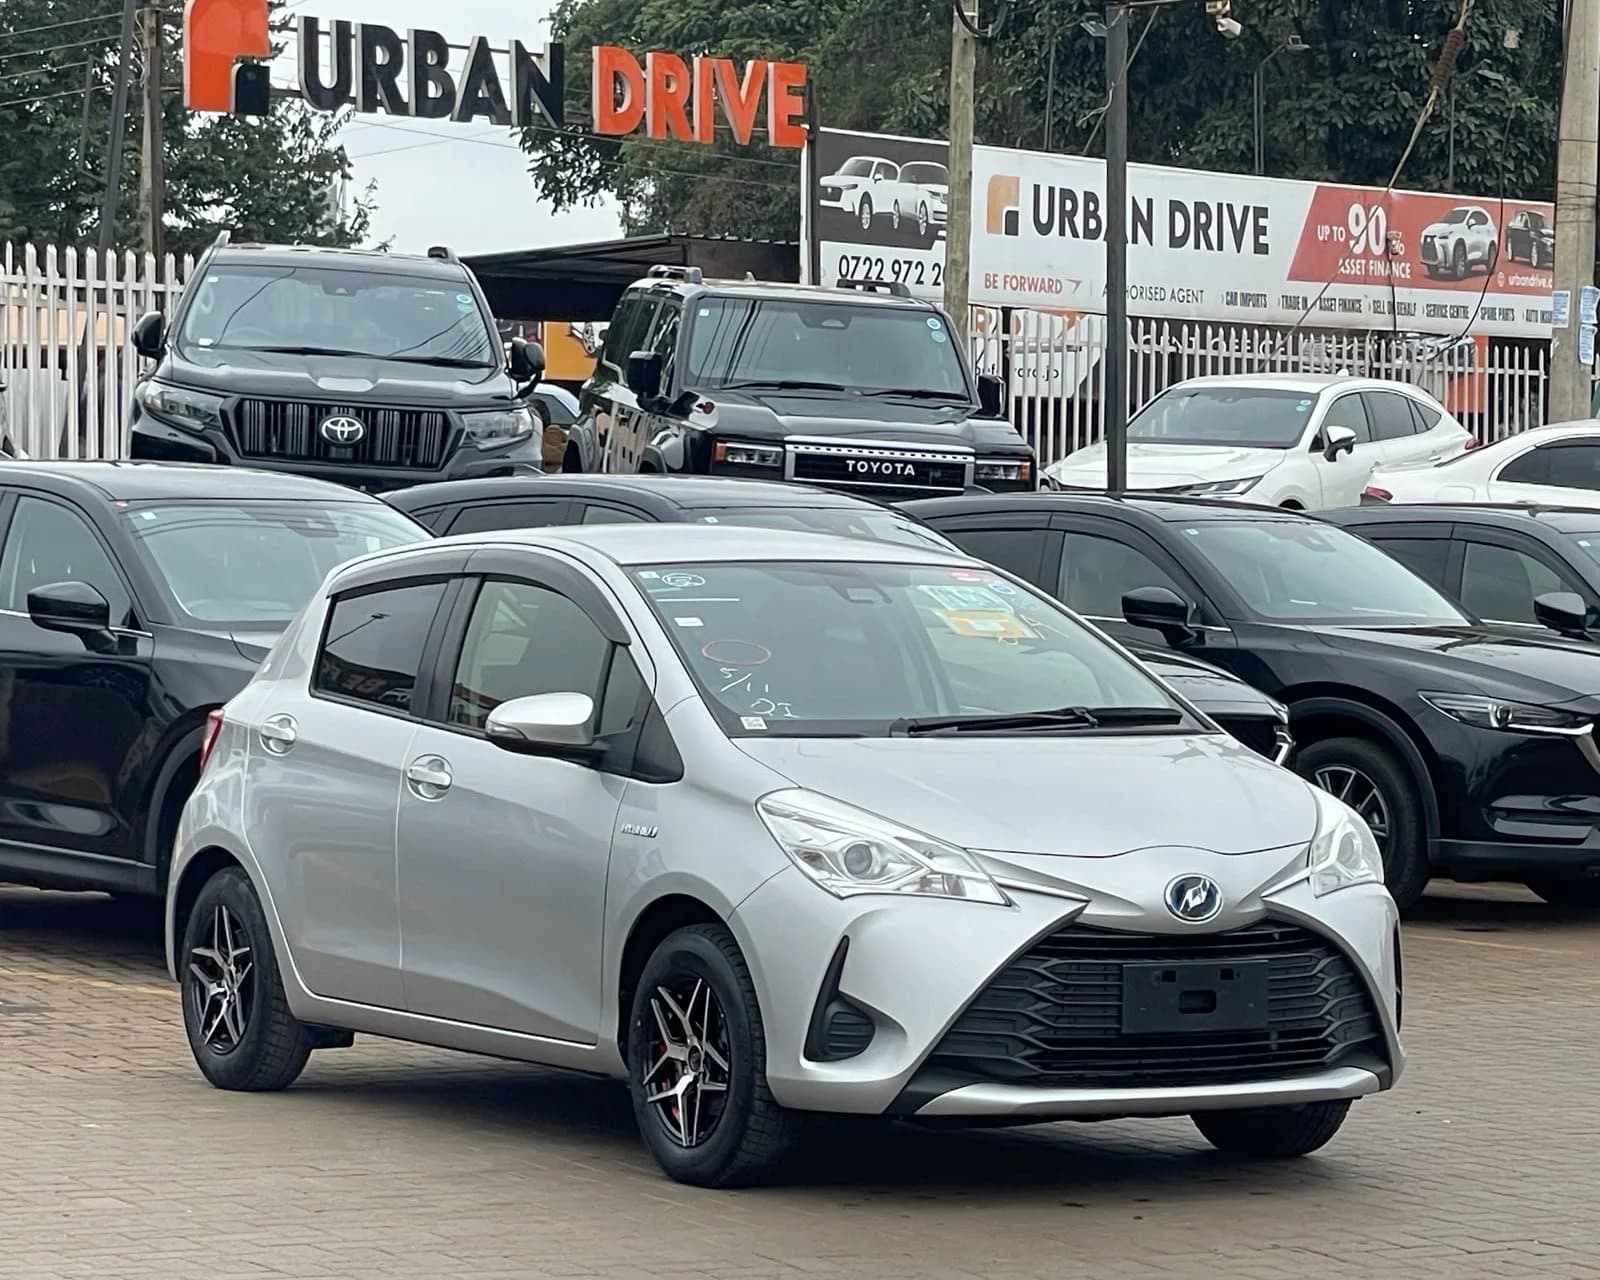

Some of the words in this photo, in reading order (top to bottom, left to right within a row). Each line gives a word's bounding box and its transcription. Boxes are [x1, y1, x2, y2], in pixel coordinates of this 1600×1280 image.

[297, 15, 565, 128] URBAN
[592, 45, 807, 148] DRIVE
[1033, 183, 1153, 246] URBN
[1169, 199, 1269, 255] DRIVE
[1317, 224, 1330, 241] UP
[1332, 226, 1346, 242] TO
[839, 255, 884, 281] 0722
[891, 259, 924, 285] 972
[1338, 258, 1366, 275] ASSET
[1369, 260, 1411, 279] FINANCE
[984, 273, 998, 289] BE
[1003, 275, 1062, 294] FORWARD
[1170, 288, 1204, 303] AGENT
[1240, 292, 1267, 308] IMPORTS
[1282, 295, 1300, 311] TRADE
[1426, 304, 1448, 319] SERVICE
[1449, 305, 1469, 320] CENTRE
[846, 460, 915, 476] TOYOTA
